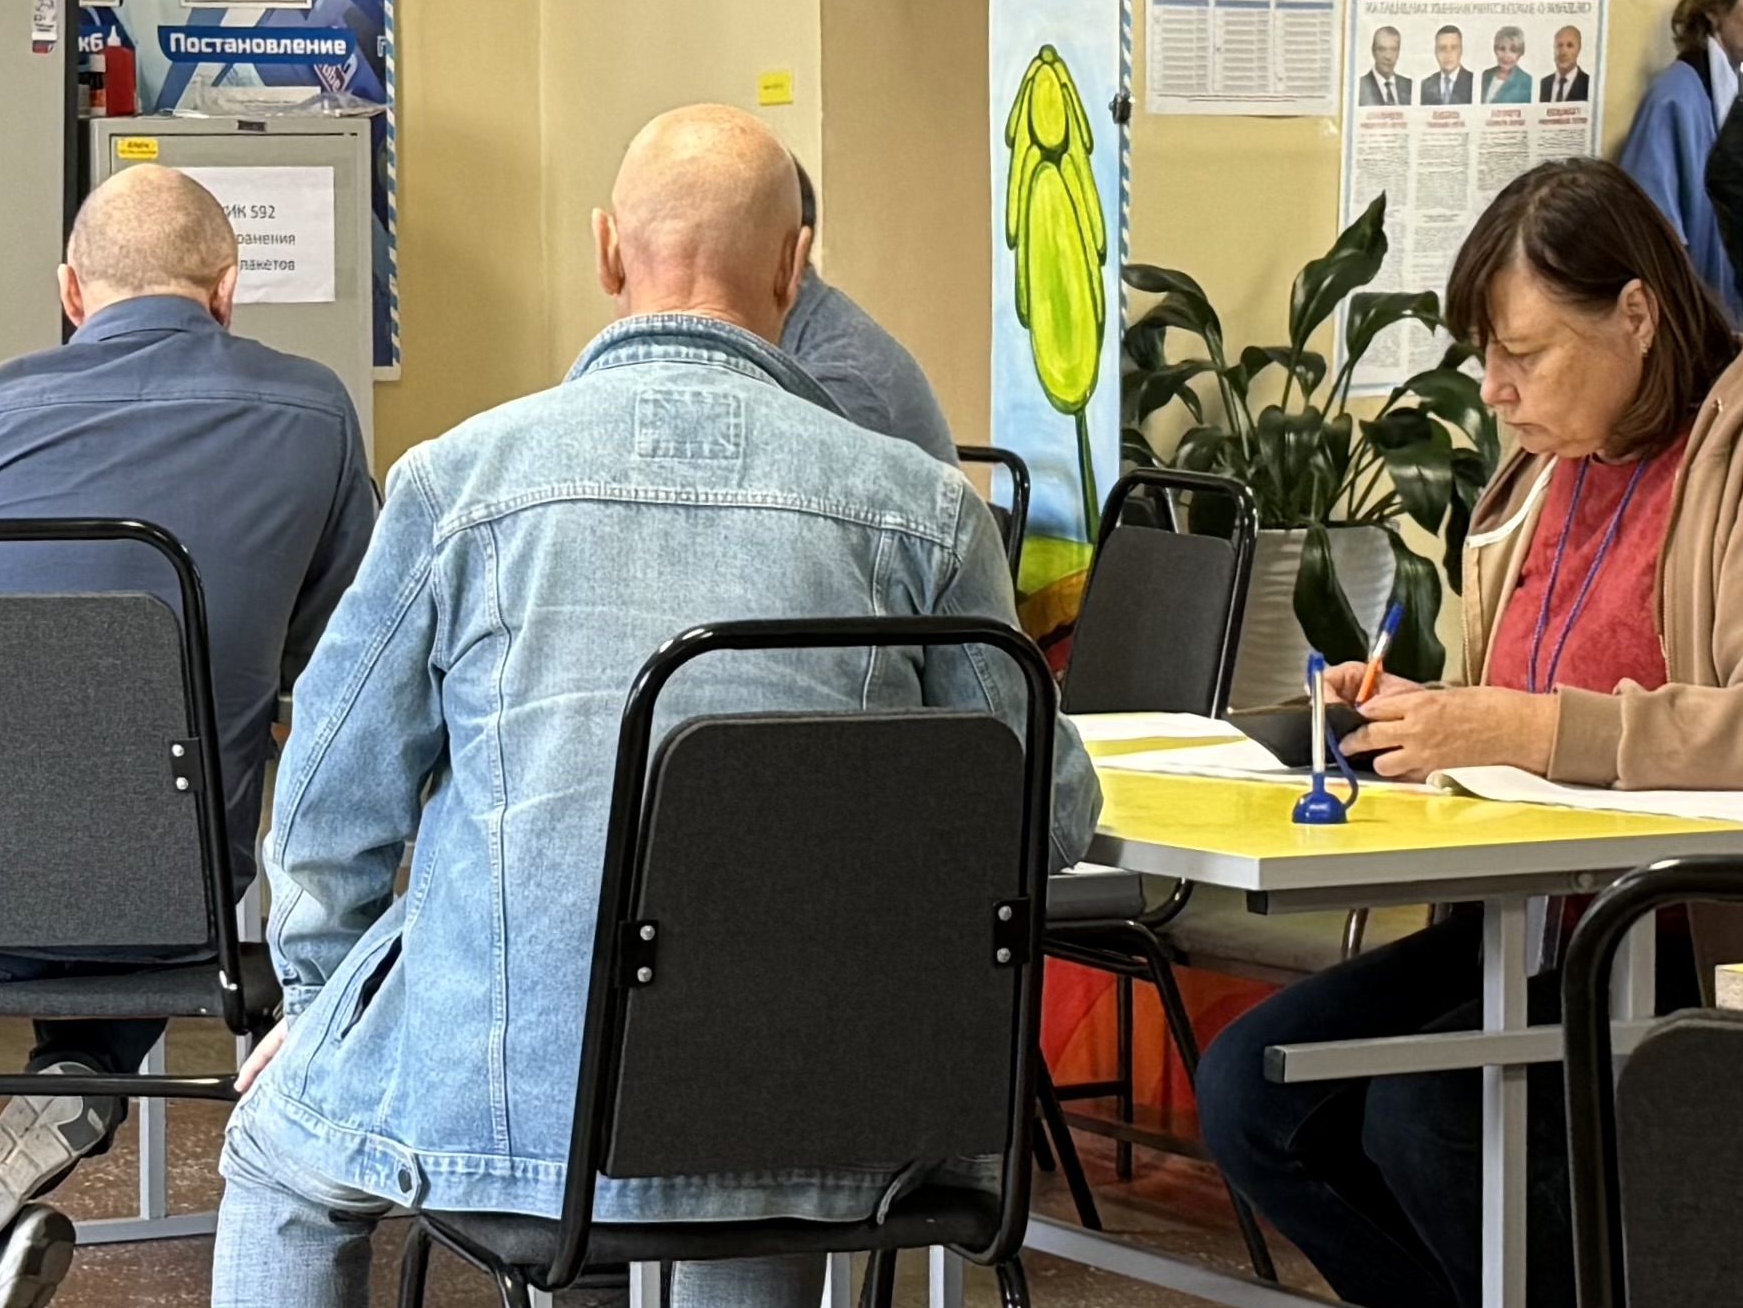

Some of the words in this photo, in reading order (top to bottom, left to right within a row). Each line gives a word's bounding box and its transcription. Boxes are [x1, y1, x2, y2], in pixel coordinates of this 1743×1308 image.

[169, 33, 347, 56] Постановление
[250, 204, 276, 219] 592
[236, 233, 296, 246] ранения
[240, 259, 295, 271] пакетов
